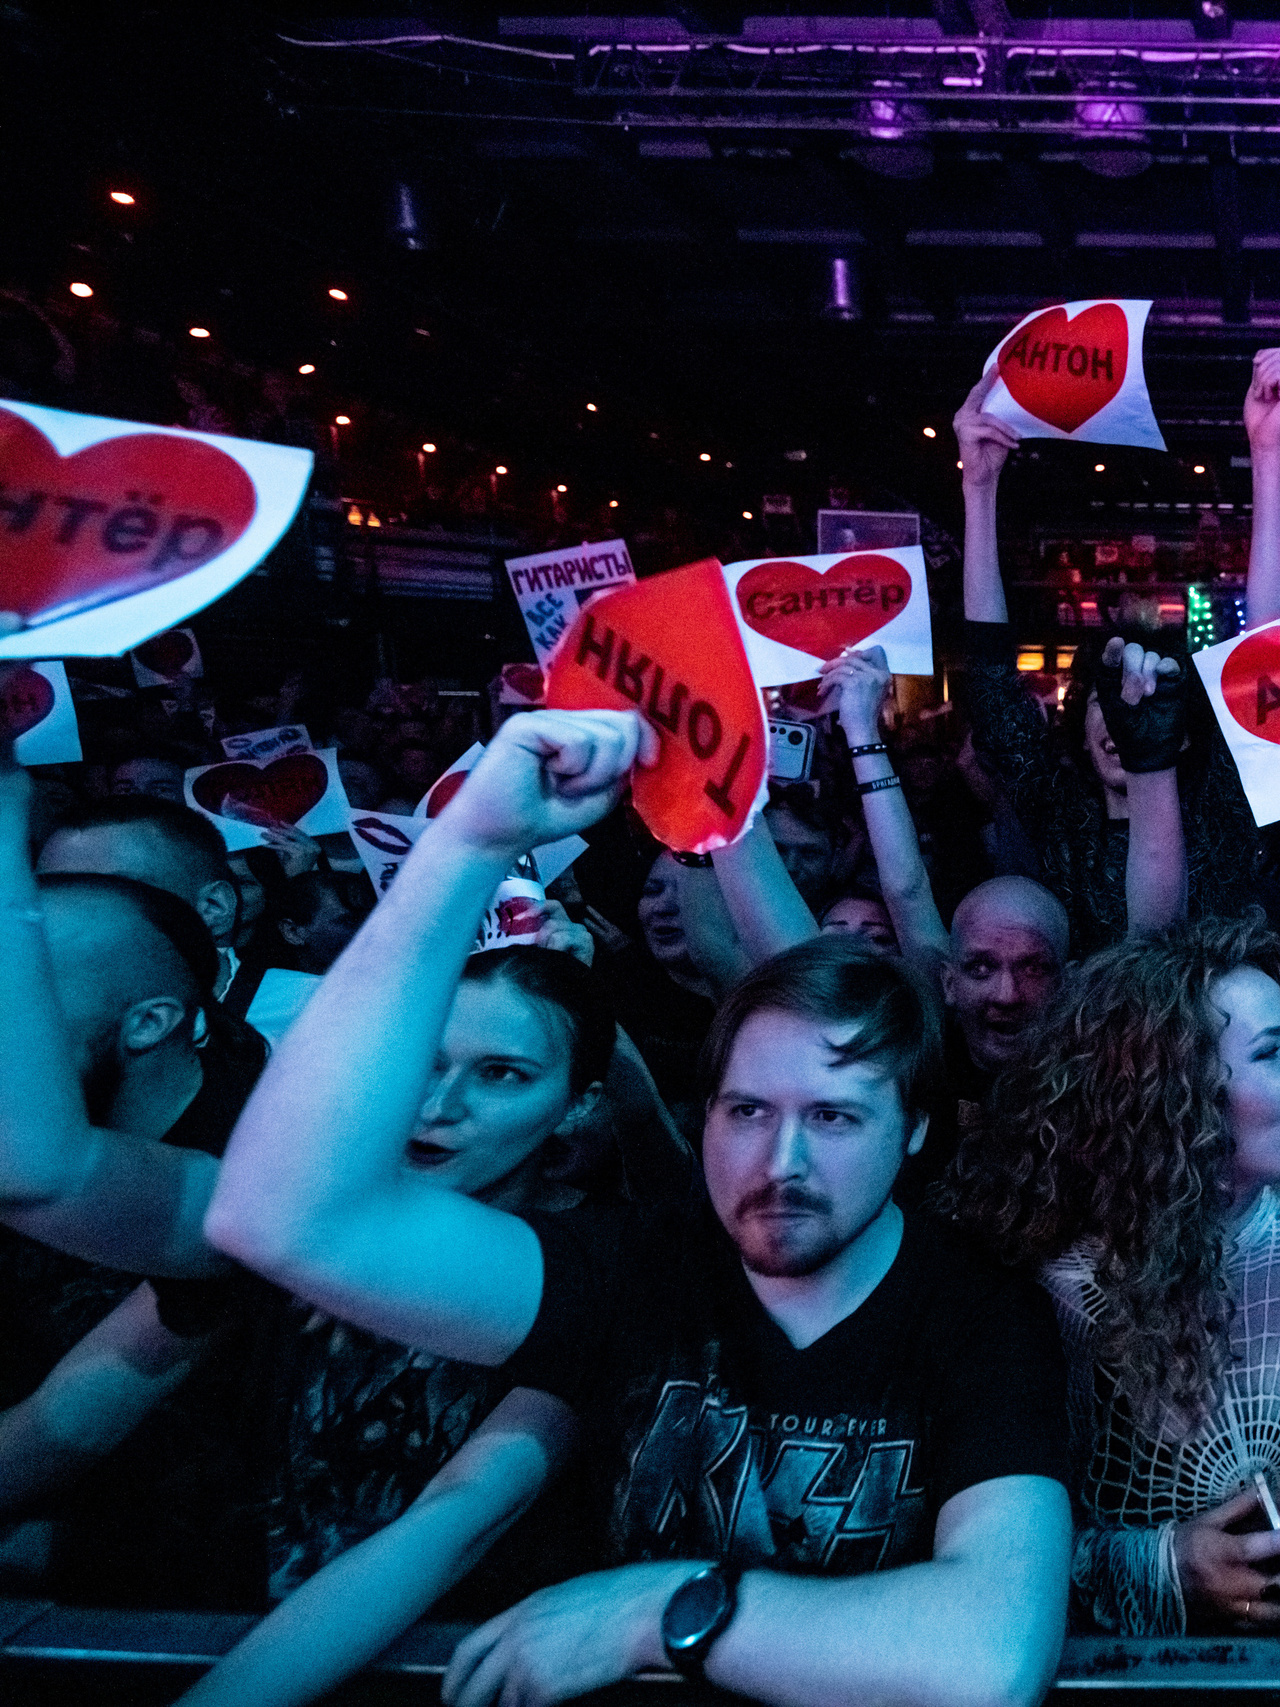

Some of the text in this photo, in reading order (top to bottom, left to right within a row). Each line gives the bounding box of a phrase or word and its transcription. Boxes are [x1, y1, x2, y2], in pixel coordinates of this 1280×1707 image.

[512, 551, 632, 596] ГИТАРИСТЫ
[746, 577, 905, 620] Сантёр
[770, 1413, 888, 1438] TOUR EVER
